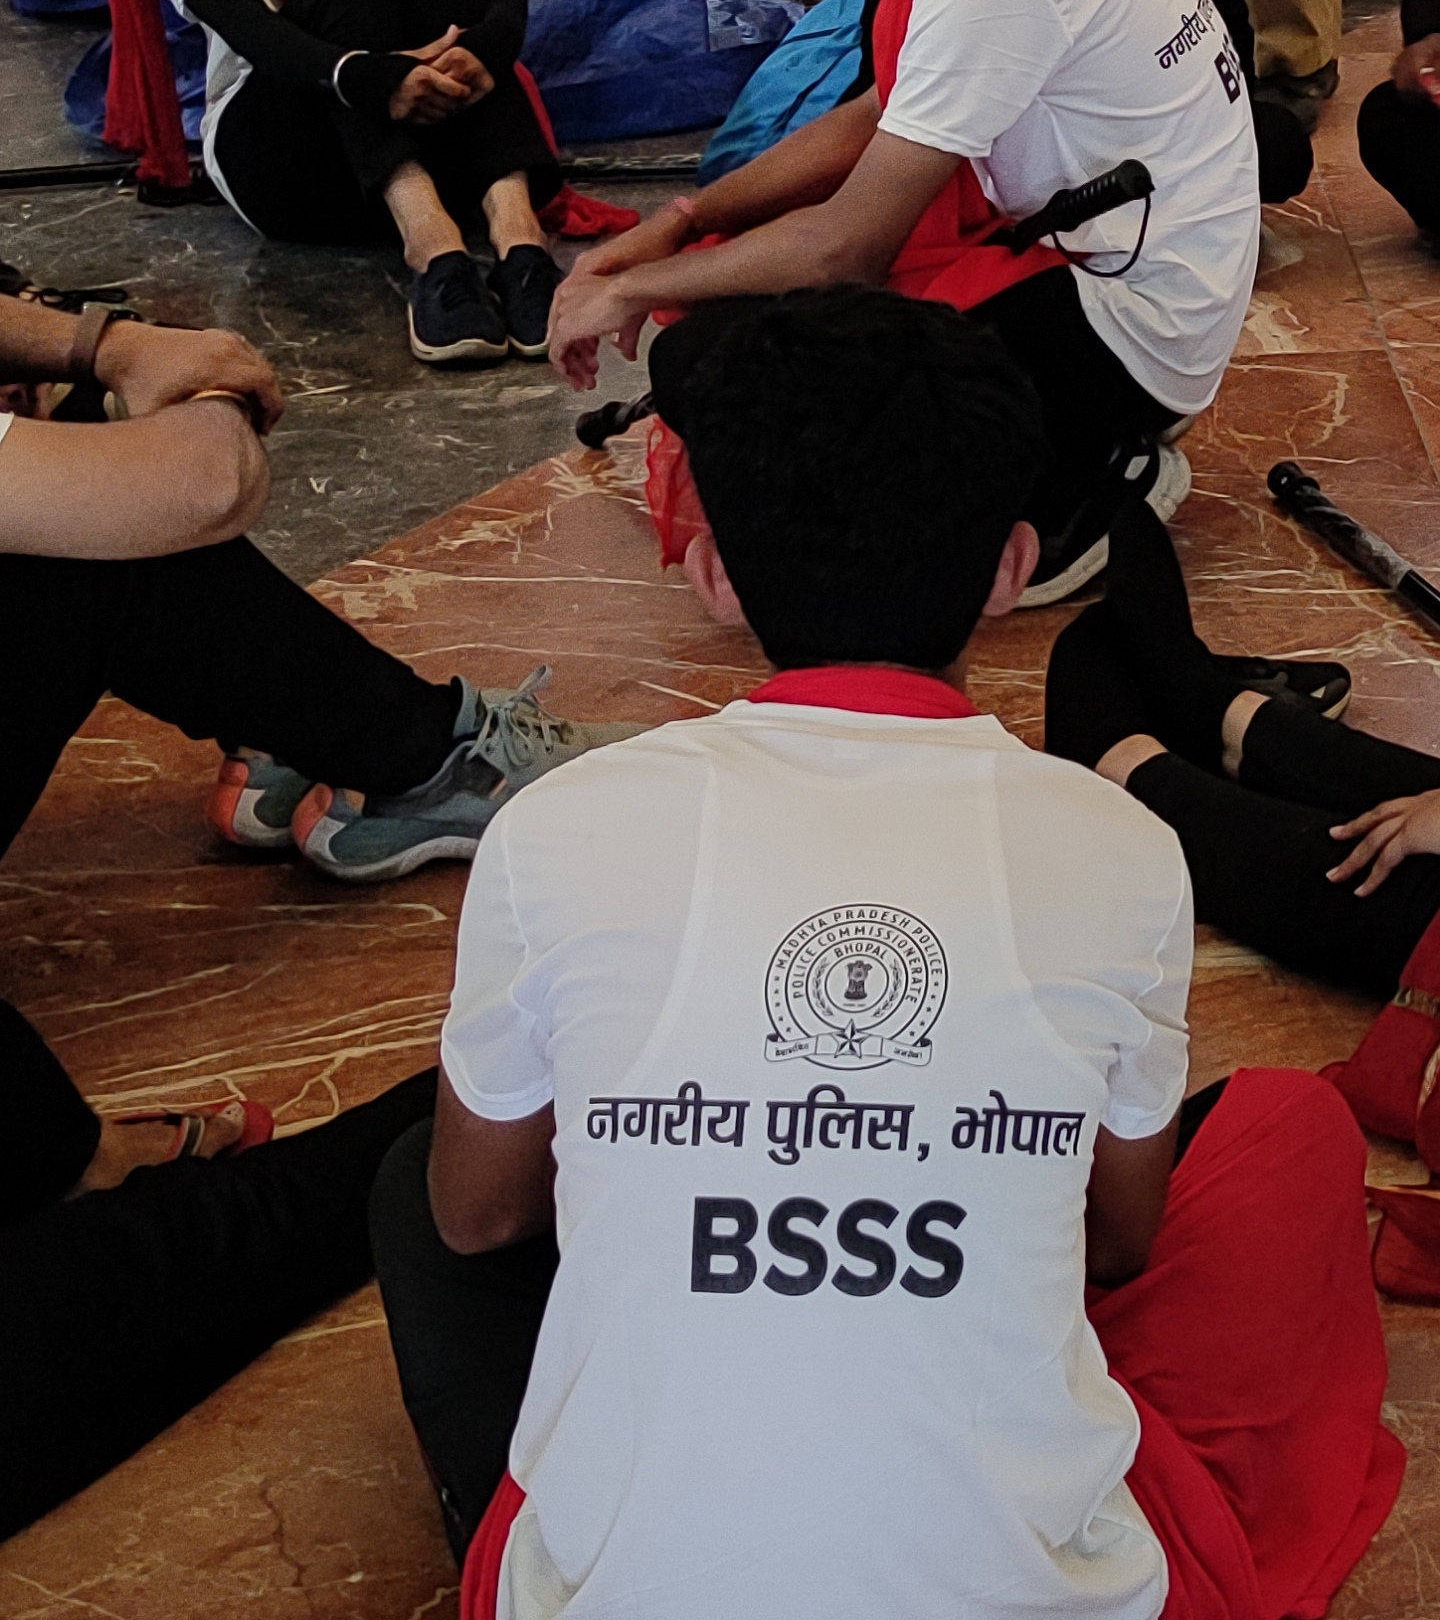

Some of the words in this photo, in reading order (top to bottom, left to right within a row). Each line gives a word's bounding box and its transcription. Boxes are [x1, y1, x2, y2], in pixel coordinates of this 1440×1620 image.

[776, 918, 828, 970] MADHYA
[832, 908, 911, 929] PRADESH
[911, 926, 943, 976] POLICE
[792, 949, 818, 1000] POLICE
[817, 925, 923, 1004] COMMISSIONERATE
[833, 942, 890, 960] BHOPAL
[586, 1081, 751, 1147] नगरीय
[766, 1085, 930, 1165] पुलिस,
[951, 1090, 1086, 1157] भोपाल
[690, 1195, 969, 1299] BSSS
